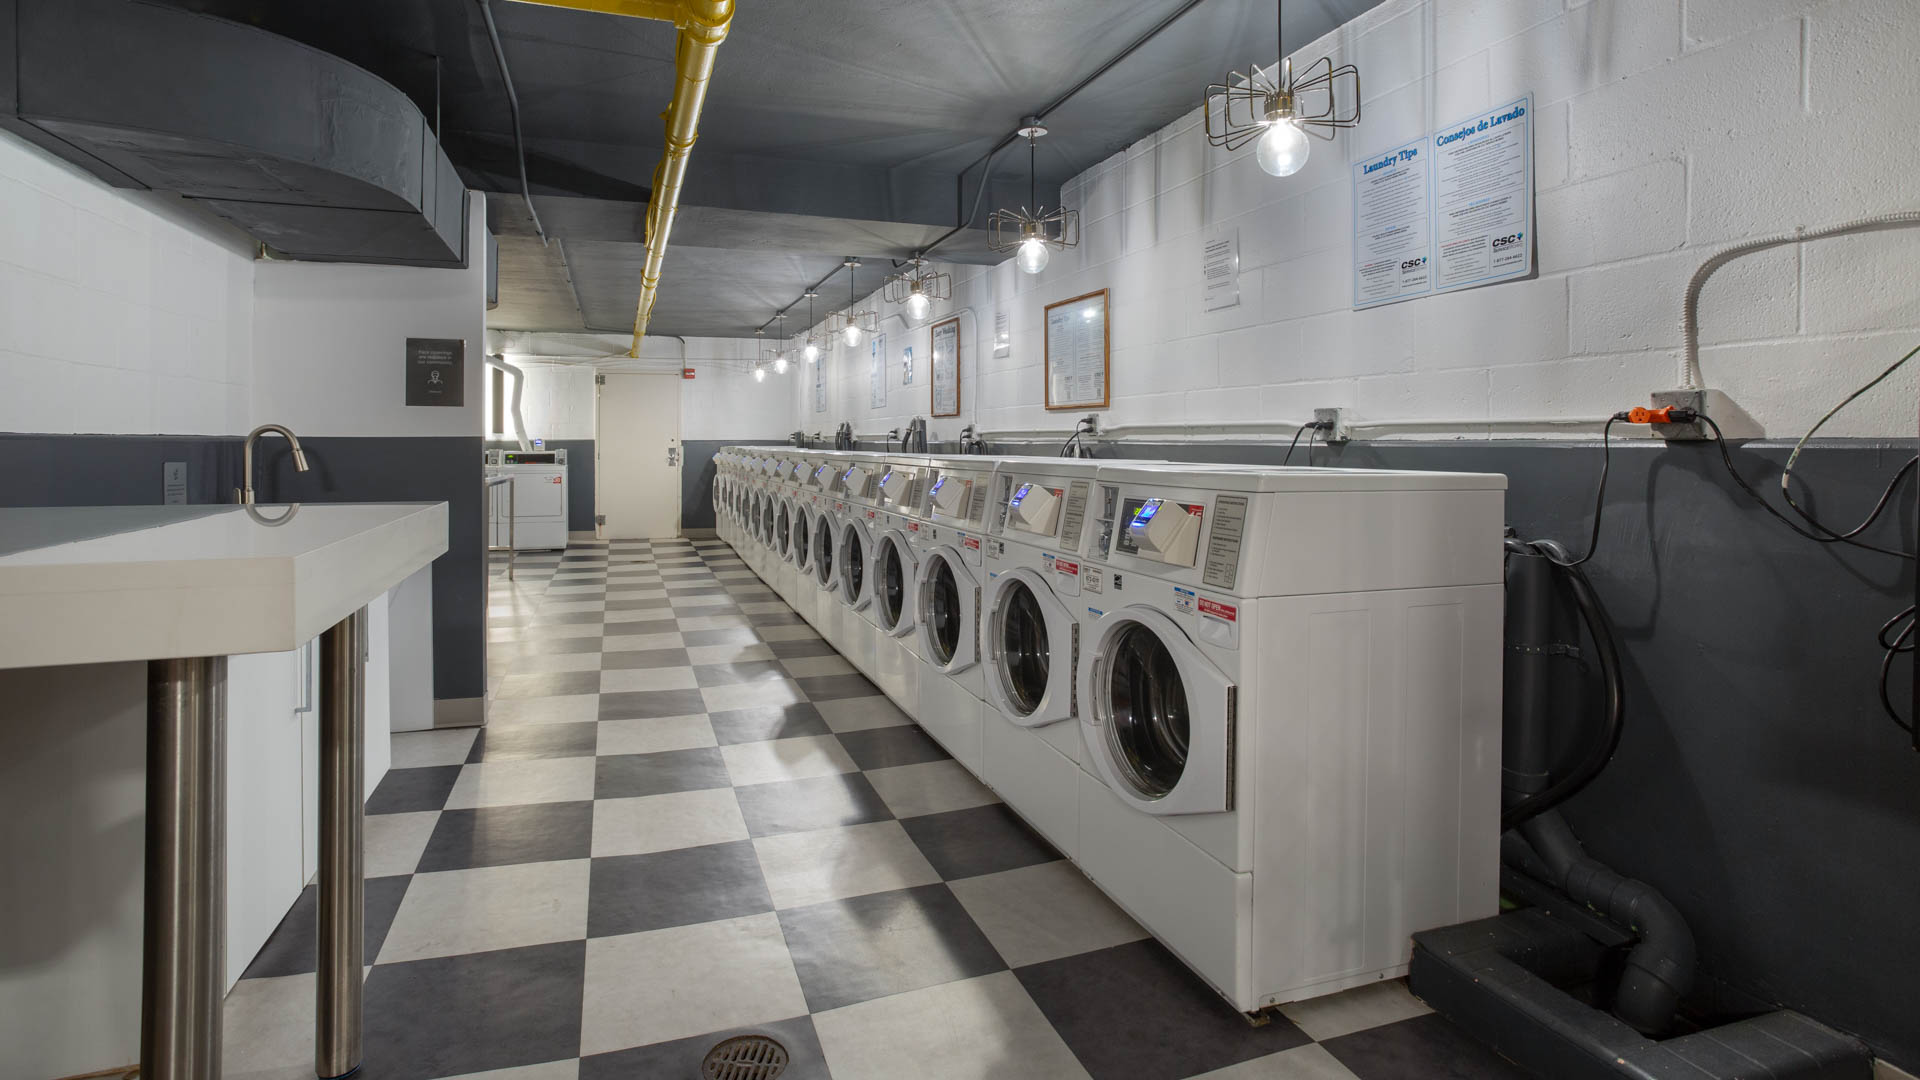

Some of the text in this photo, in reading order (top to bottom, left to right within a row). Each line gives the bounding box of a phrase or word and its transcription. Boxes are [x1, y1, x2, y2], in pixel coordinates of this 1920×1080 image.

[1436, 106, 1526, 147] Consejos de Lavado
[1363, 155, 1398, 175] Laundry
[1398, 148, 1418, 161] Tips
[1492, 234, 1516, 247] CSC
[1401, 258, 1421, 269] CSC
